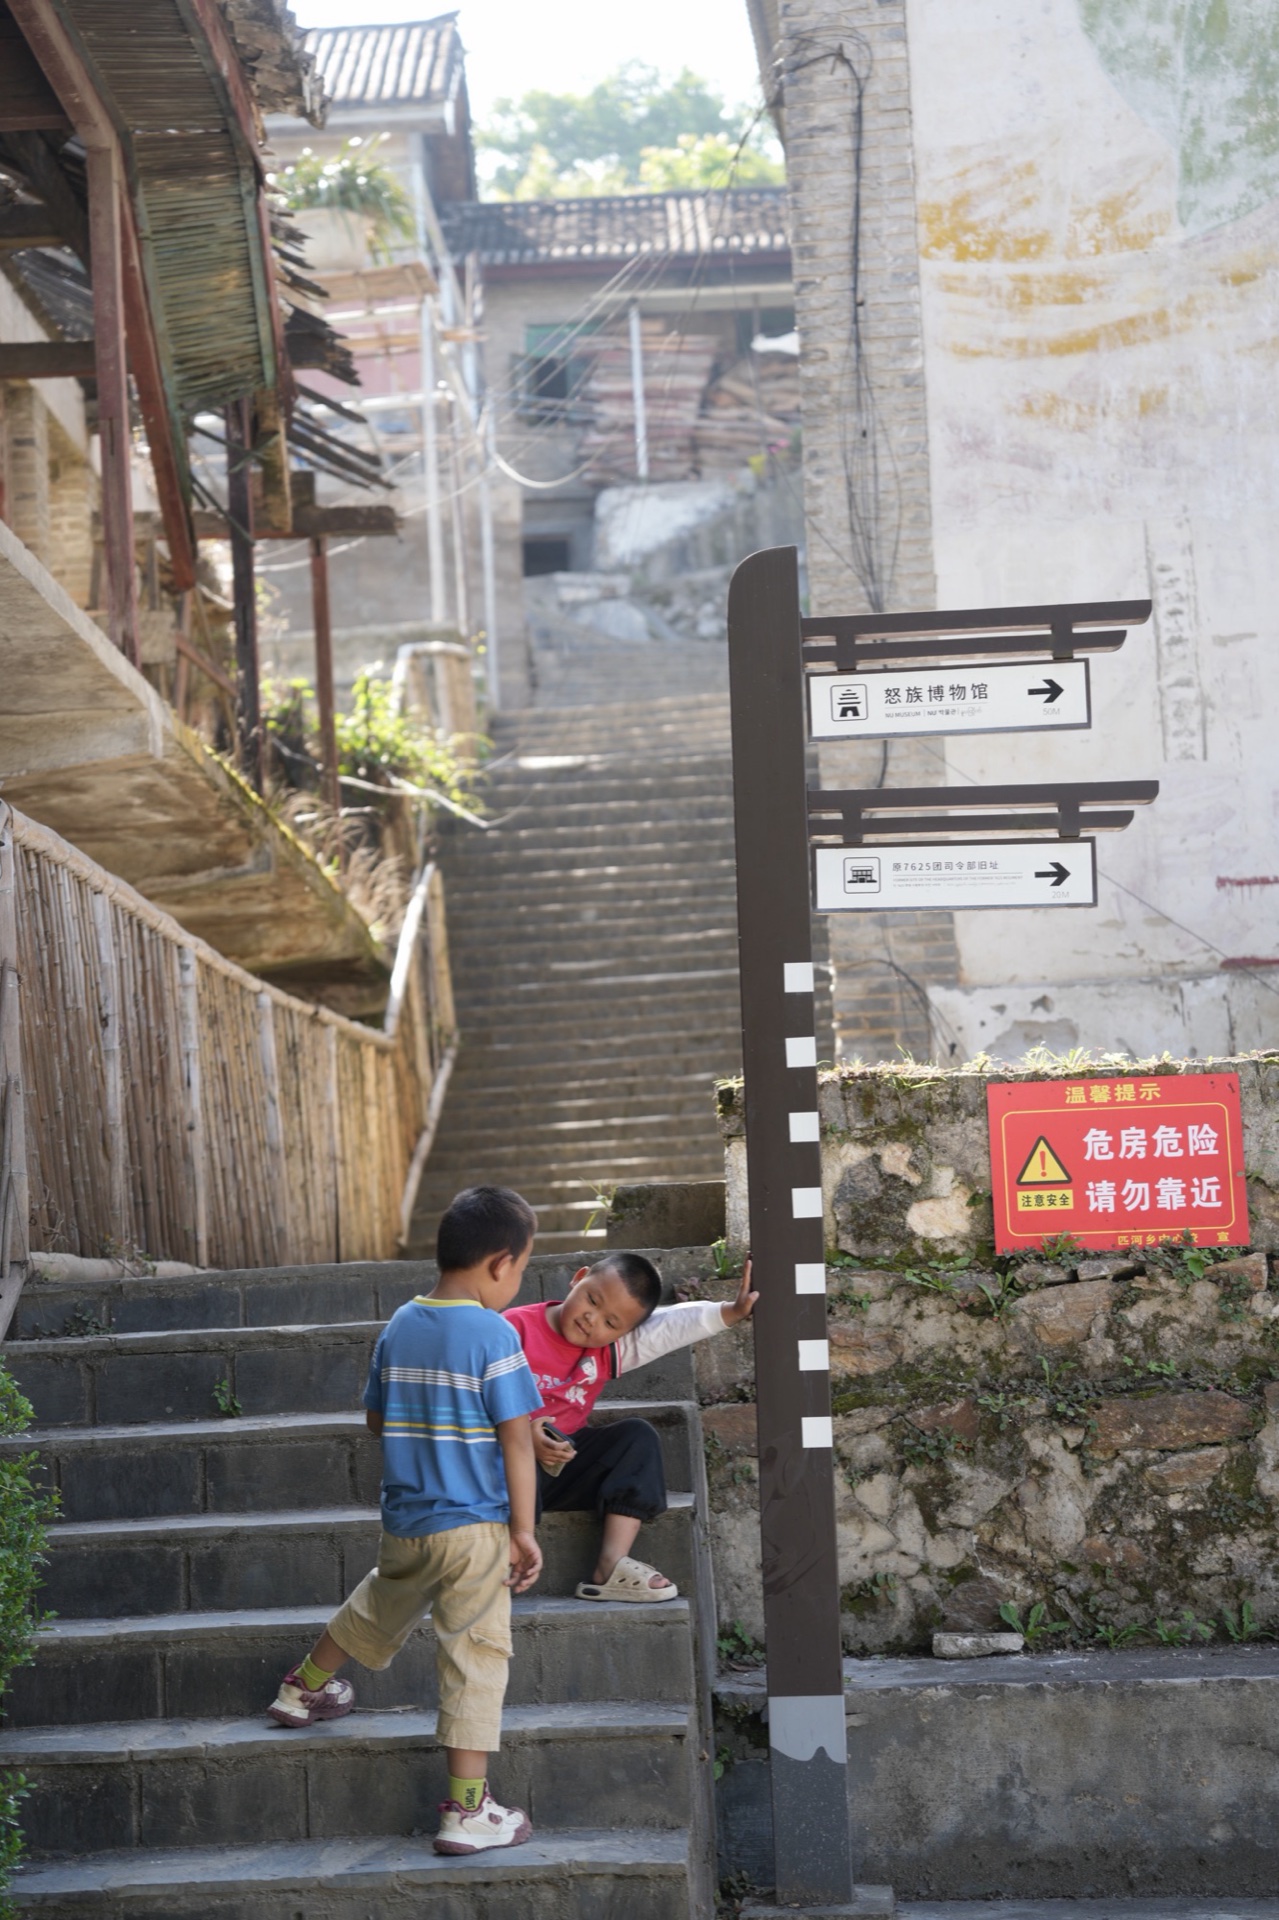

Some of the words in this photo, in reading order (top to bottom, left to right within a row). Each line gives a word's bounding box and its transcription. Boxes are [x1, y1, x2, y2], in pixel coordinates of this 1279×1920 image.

[884, 683, 989, 705] 怒族博物馆
[892, 860, 999, 872] 原7625团司令部旧址
[1051, 890, 1070, 898] 20M
[1065, 1082, 1162, 1104] 温馨提示
[1082, 1123, 1219, 1161] 危房危险
[1021, 1193, 1070, 1207] 注意安全
[1085, 1176, 1223, 1213] 请勿靠近
[1216, 1231, 1230, 1242] 宣
